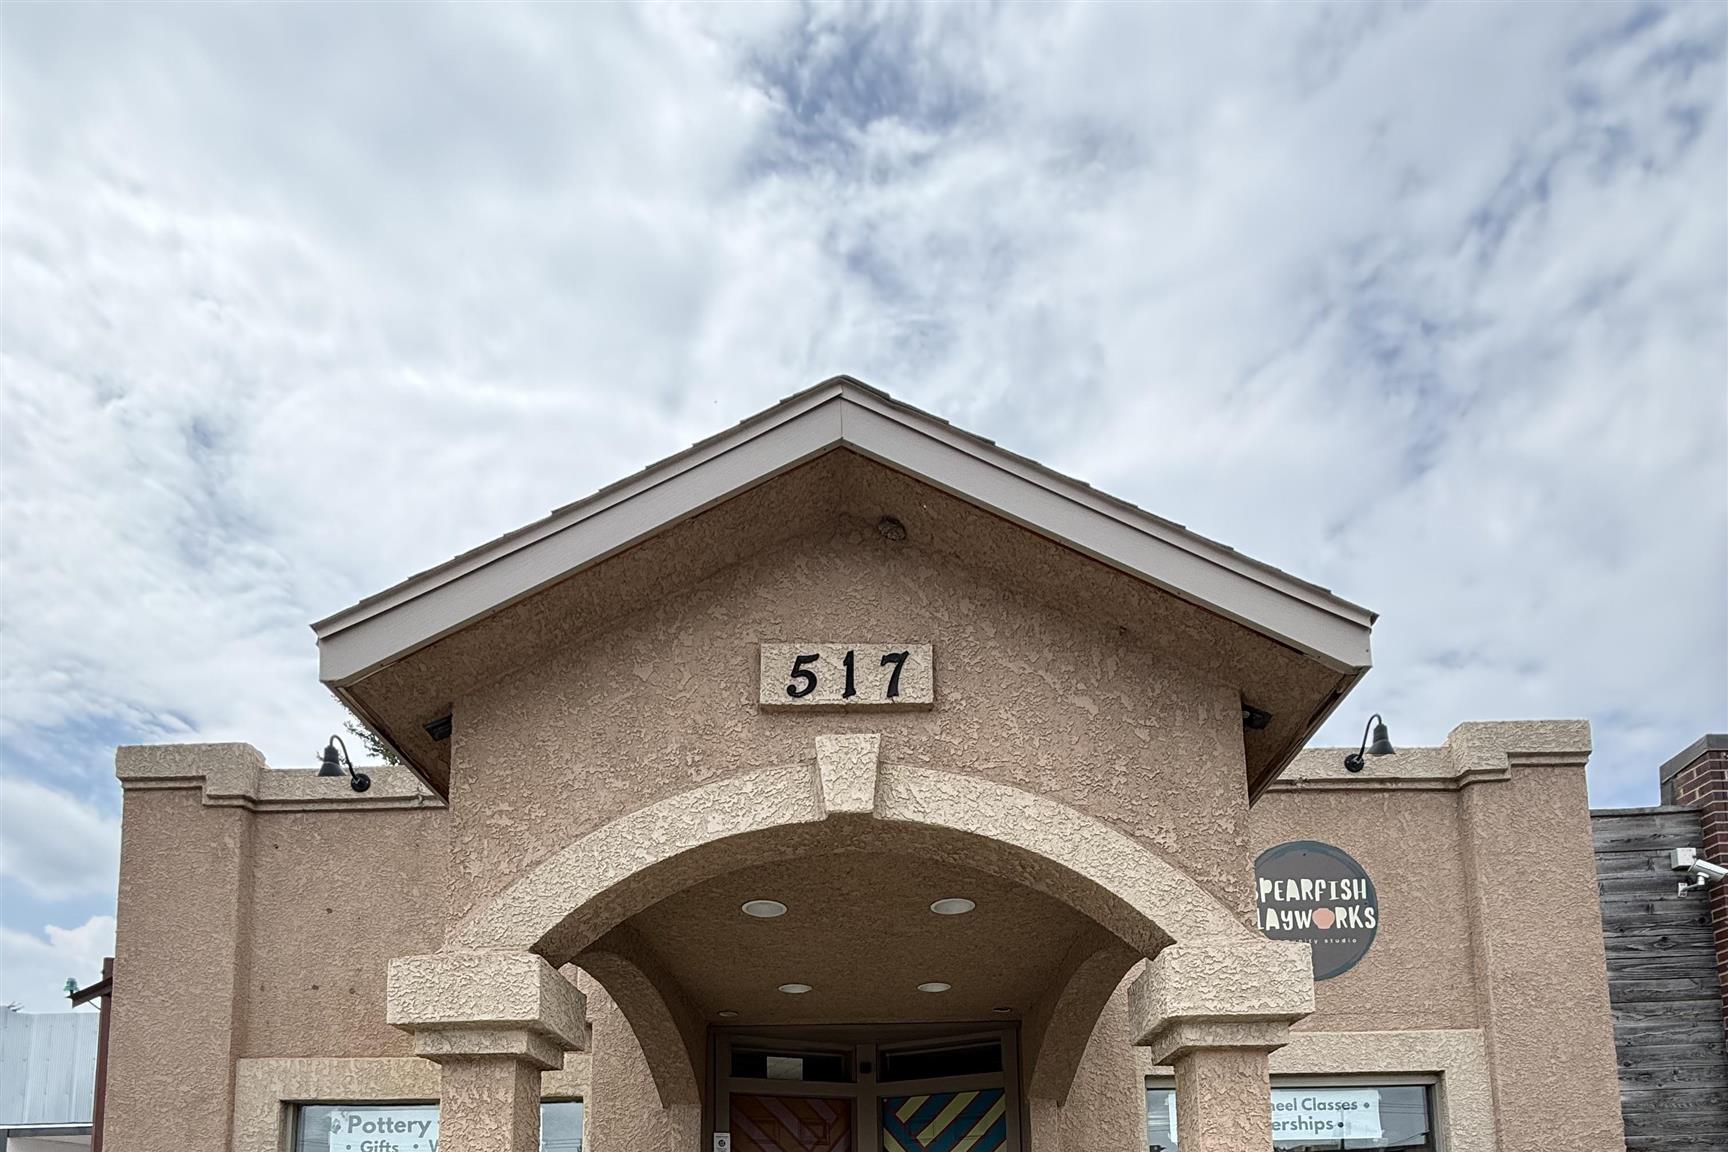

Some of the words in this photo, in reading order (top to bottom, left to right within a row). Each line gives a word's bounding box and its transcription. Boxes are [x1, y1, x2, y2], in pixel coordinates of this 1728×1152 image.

[787, 650, 909, 698] 517
[1256, 877, 1367, 903] PEARFISH
[1257, 905, 1376, 931] LAYWORKS
[1301, 1097, 1358, 1111] Classes
[347, 1115, 432, 1138] Pottery
[1271, 1115, 1334, 1134] erships
